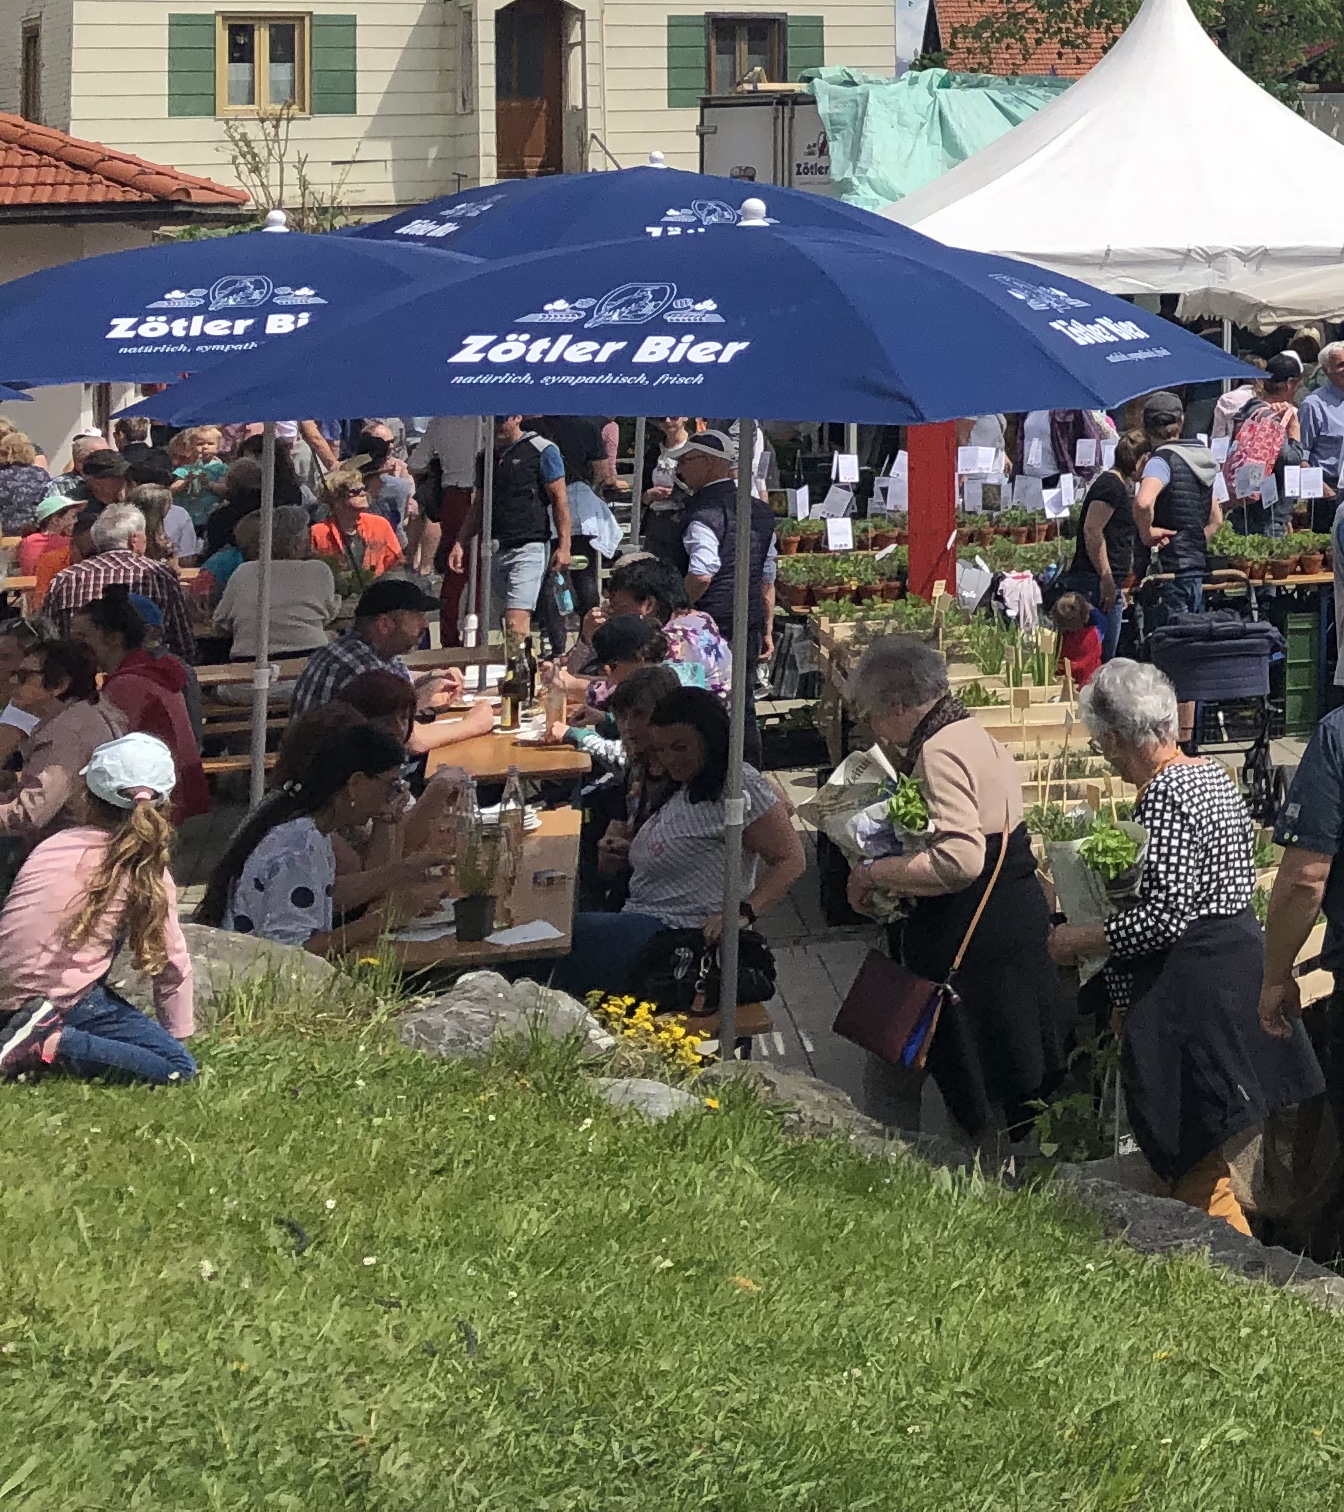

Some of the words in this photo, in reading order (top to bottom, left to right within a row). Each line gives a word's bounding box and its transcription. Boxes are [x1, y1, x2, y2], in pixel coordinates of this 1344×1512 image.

[105, 315, 255, 339] Zötler
[265, 312, 311, 335] Bi
[119, 343, 192, 354] natürlich,
[196, 341, 259, 352] sympath
[447, 334, 628, 363] Zötler
[631, 335, 751, 363] Bier
[450, 372, 535, 386] natürlich,
[540, 372, 650, 387] sympathisch,
[652, 372, 704, 387] frisch
